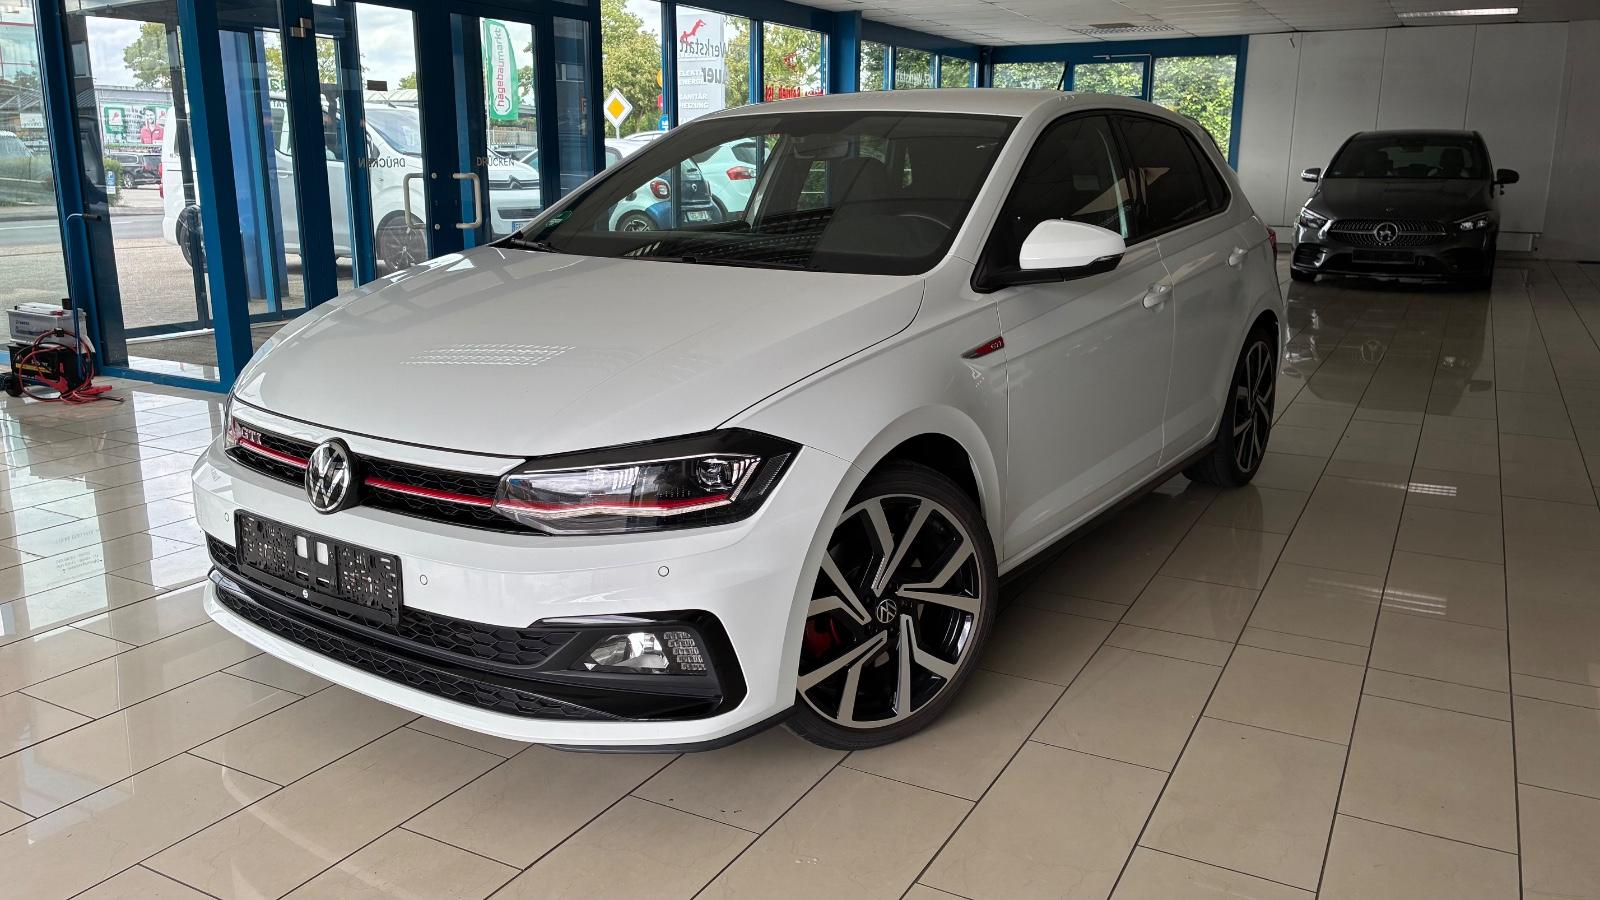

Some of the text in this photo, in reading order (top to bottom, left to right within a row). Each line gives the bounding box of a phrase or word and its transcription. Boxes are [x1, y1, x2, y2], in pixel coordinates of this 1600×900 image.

[494, 27, 506, 107] hagebaumarkt
[476, 155, 515, 168] DRÜCKEN
[241, 426, 263, 446] GTI
